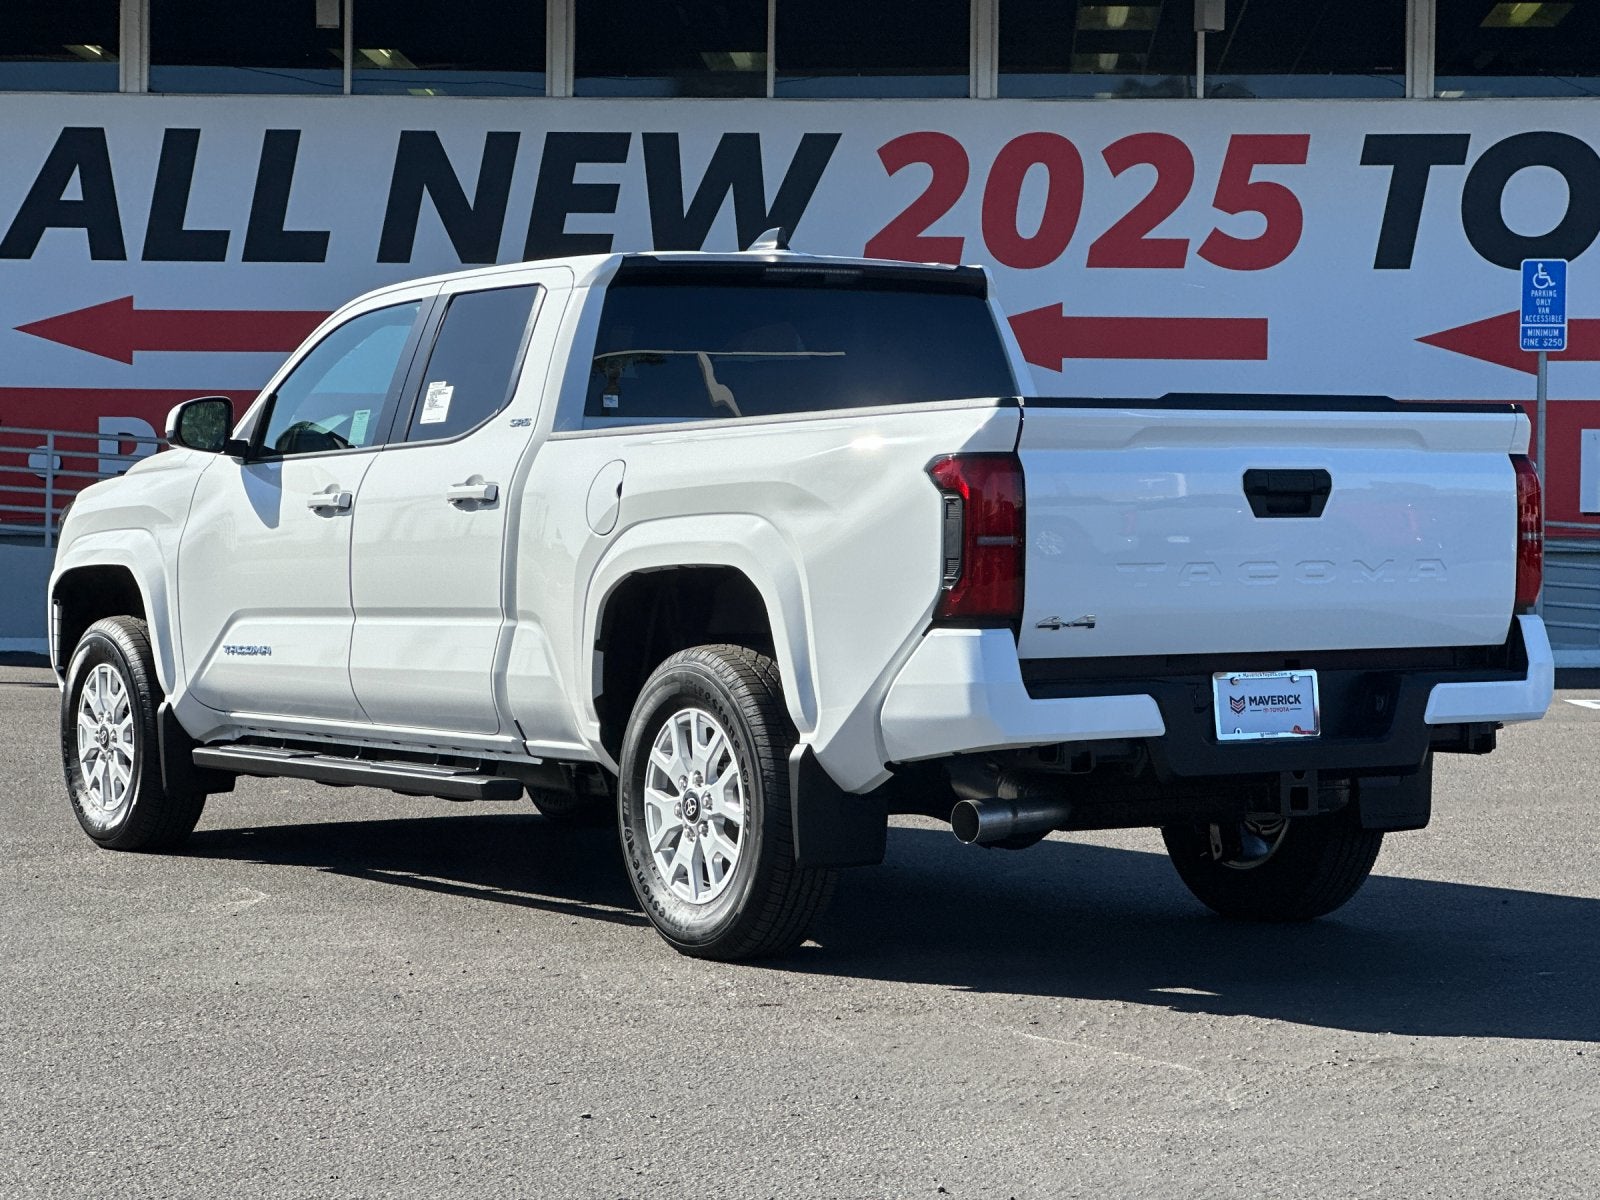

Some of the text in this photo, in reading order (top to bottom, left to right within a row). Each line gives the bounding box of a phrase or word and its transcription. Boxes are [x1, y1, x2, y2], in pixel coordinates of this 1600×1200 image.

[0, 126, 330, 262] ALL
[377, 131, 842, 264] NEW
[864, 131, 1311, 271] 2025
[1530, 289, 1557, 298] PARKING
[1535, 298, 1552, 306] ONLY
[1537, 306, 1550, 314] VAN
[1524, 314, 1563, 323] ACCESSIBLE
[1527, 328, 1559, 337] MINIMUM
[1523, 338, 1563, 347] FINE $250
[1115, 558, 1448, 587] TACOMA
[1248, 694, 1302, 706] MAVERICK
